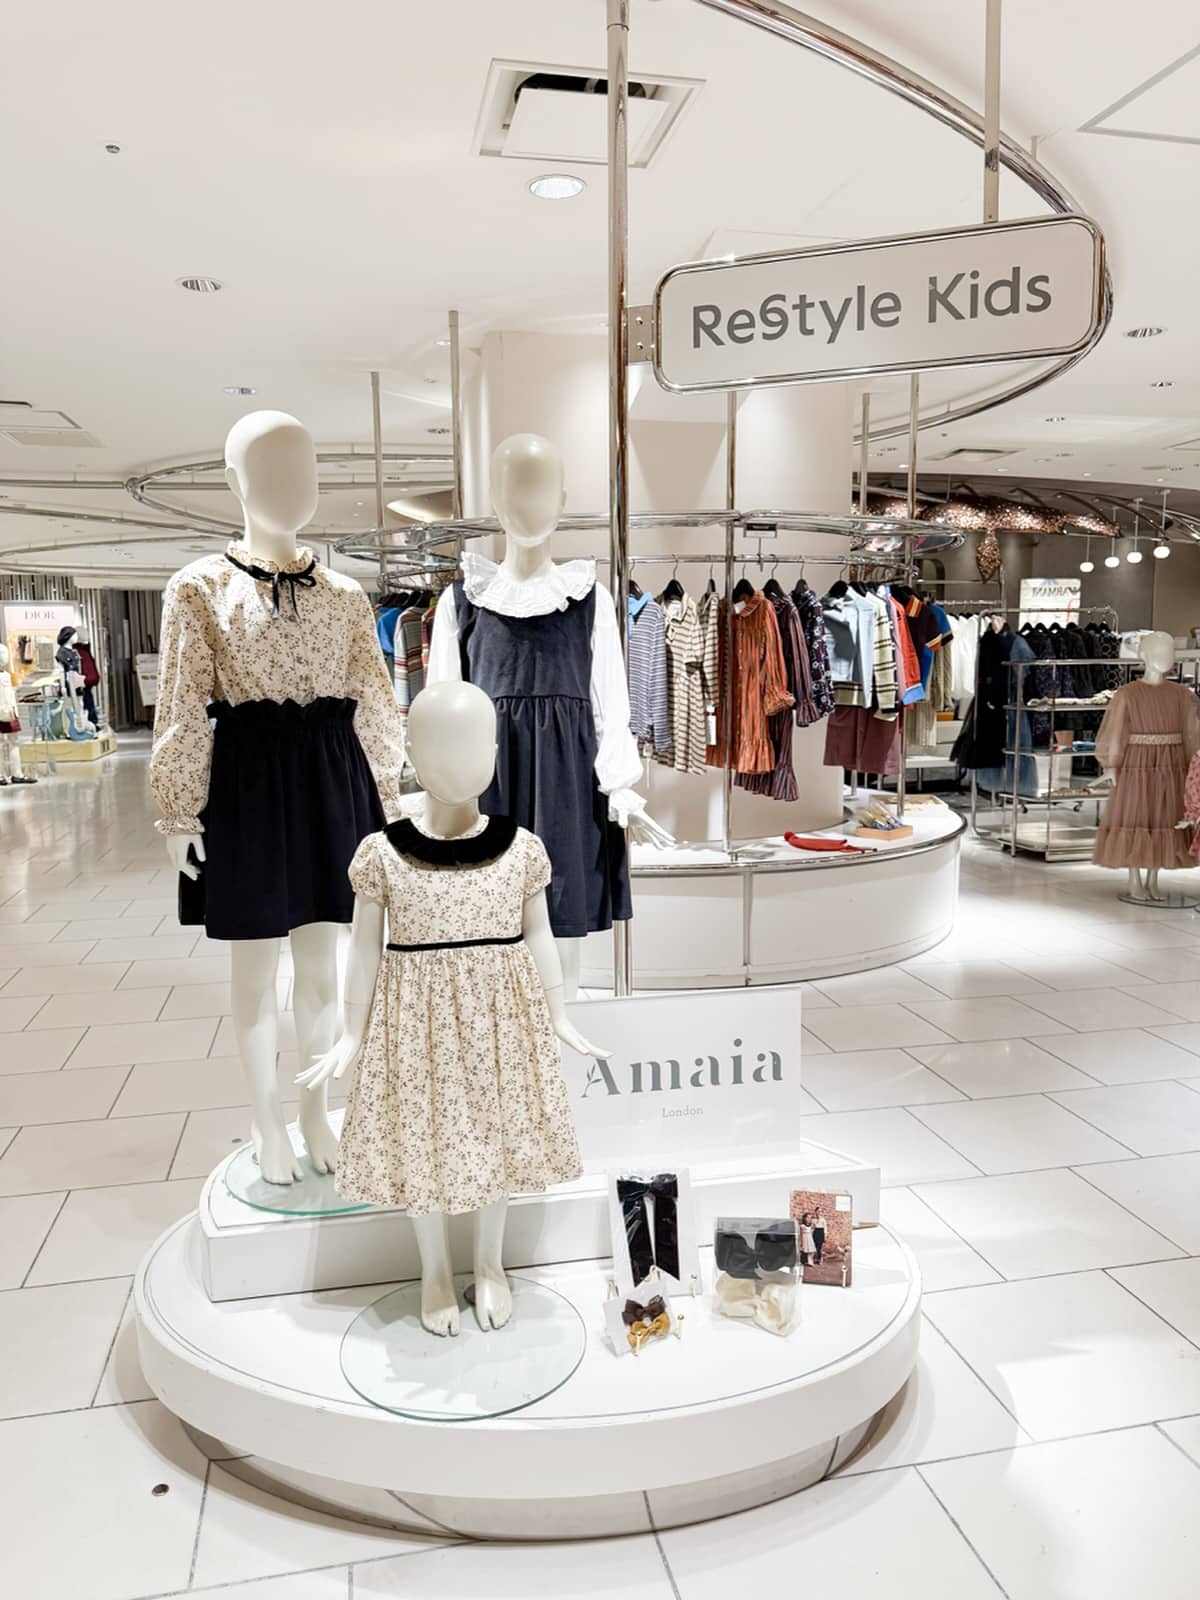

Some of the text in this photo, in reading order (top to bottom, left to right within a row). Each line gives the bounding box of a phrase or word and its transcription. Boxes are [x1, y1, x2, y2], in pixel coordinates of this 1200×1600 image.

[692, 266, 1052, 349] ReStyle Kids
[580, 1037, 784, 1099] Amaia
[661, 1104, 705, 1119] London
